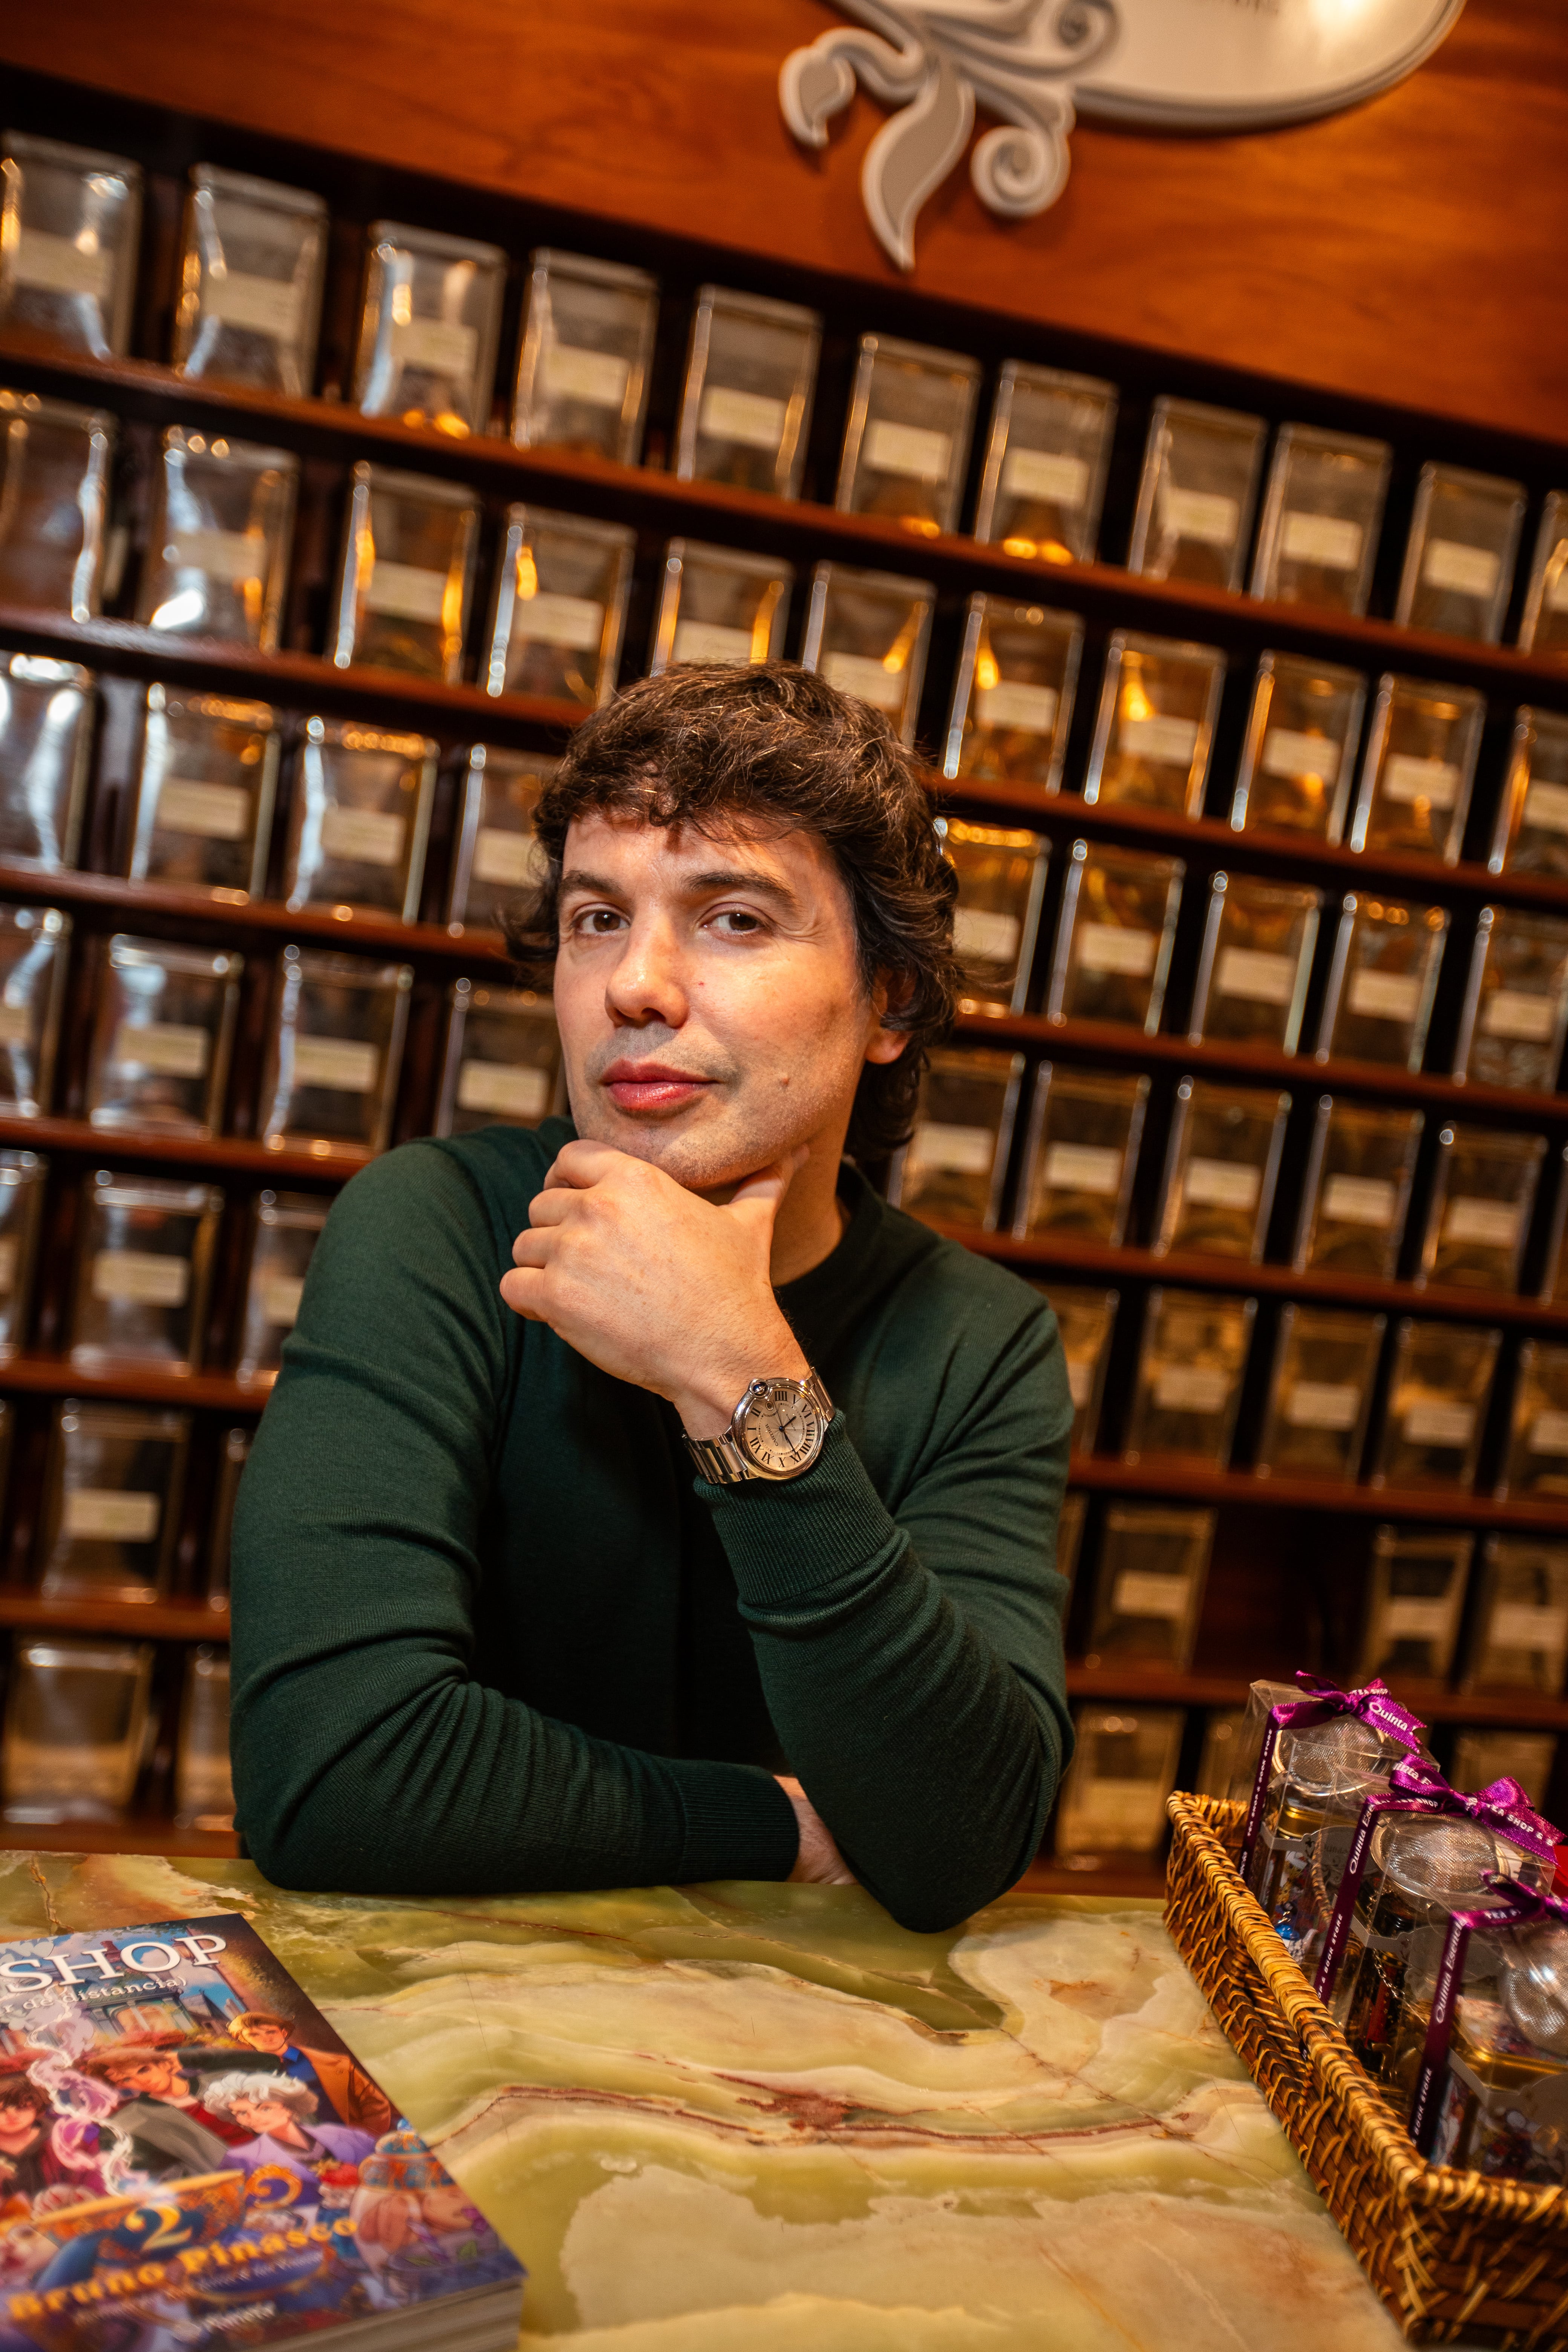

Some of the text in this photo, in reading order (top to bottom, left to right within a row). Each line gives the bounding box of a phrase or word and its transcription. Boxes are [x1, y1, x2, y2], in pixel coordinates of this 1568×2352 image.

[765, 1423, 778, 1447] CARTIER
[786, 1413, 796, 1431] AUTOATIC
[1369, 1701, 1408, 1732] Quinta
[1263, 1728, 1272, 1757] STORE
[1506, 1813, 1534, 1833] SHOP
[1349, 1829, 1366, 1874] Quinta
[0, 1934, 227, 1994] SHOP
[1324, 1946, 1334, 1974] BOOK
[1331, 1913, 1343, 1945] STORE
[23, 1998, 54, 2009] de
[63, 1975, 187, 2003] distancia)
[1436, 1972, 1452, 2024] Quinta
[1414, 2104, 1424, 2136] BOOK
[1419, 2067, 1433, 2104] STORE
[125, 2207, 192, 2251] 2
[177, 2217, 357, 2274] Pinasco
